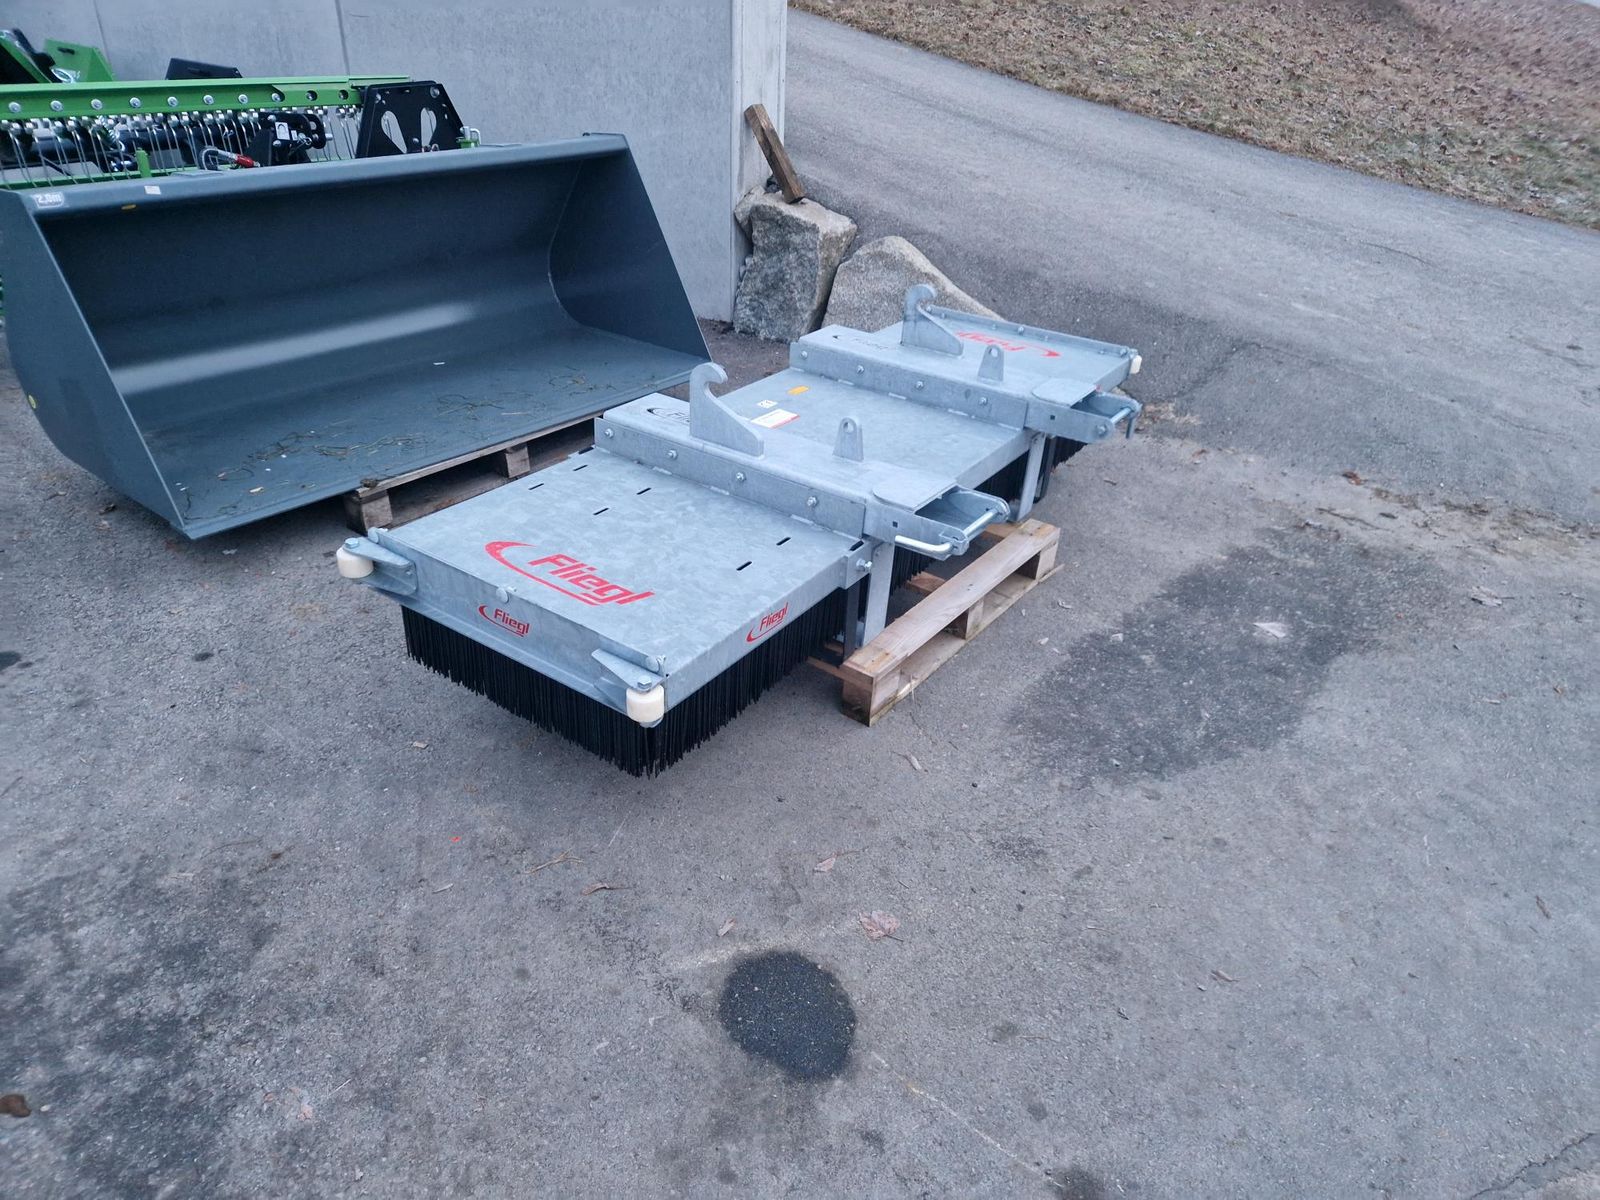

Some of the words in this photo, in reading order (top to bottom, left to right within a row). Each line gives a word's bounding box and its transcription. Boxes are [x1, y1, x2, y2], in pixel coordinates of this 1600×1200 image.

[527, 553, 655, 605] Fliegl
[494, 608, 530, 635] Fliegl
[760, 601, 789, 631] Fliegl
